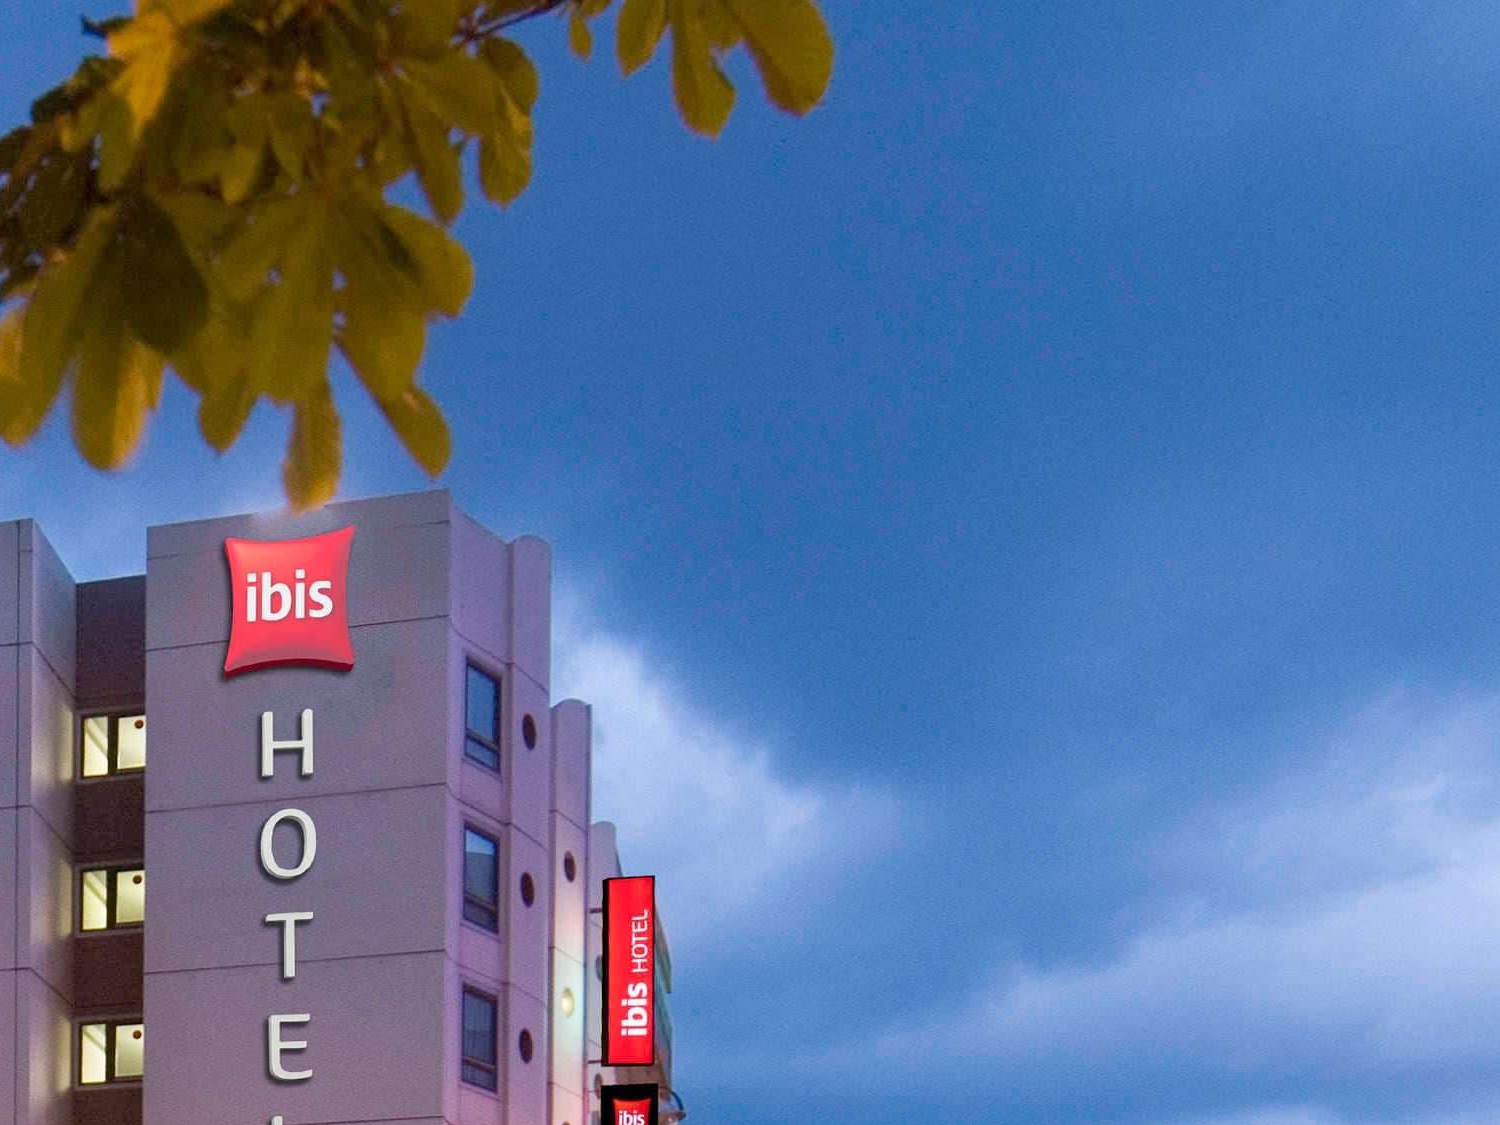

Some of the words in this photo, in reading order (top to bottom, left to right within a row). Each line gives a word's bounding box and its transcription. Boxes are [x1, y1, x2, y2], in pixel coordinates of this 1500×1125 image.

[246, 568, 334, 623] ibis
[631, 908, 649, 973] HOTEL
[620, 981, 648, 1036] ibis
